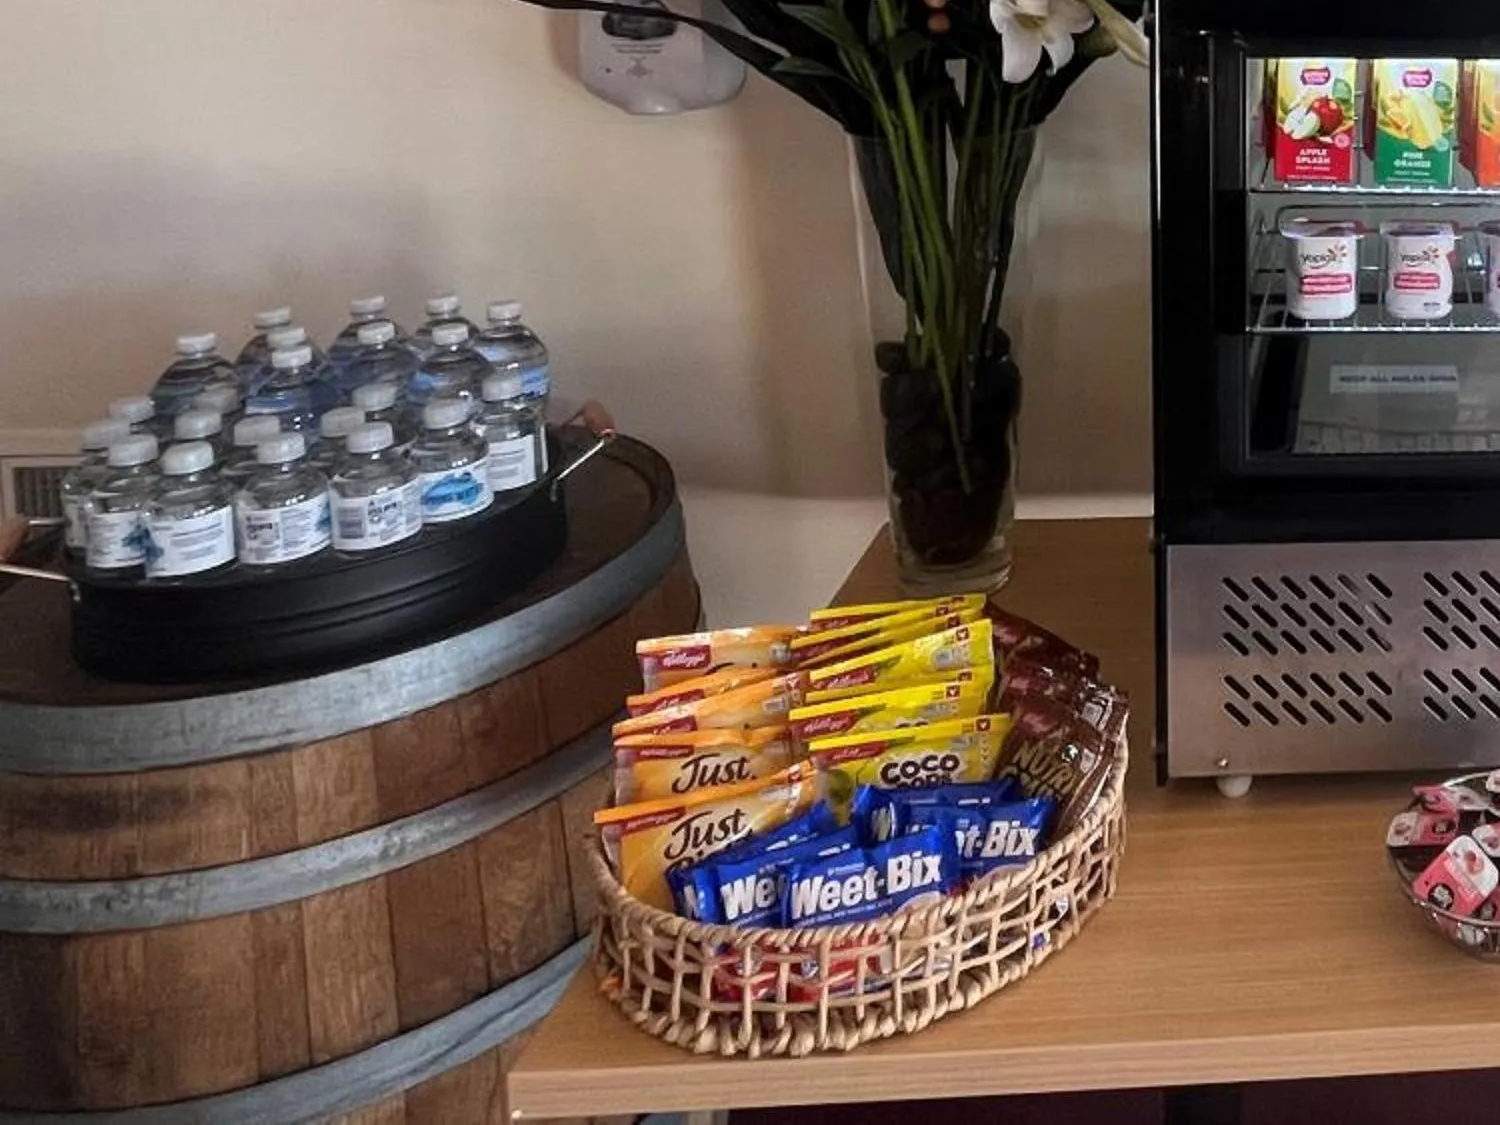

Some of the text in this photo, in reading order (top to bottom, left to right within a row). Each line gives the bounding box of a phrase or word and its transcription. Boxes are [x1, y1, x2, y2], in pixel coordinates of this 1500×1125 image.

[671, 753, 751, 794] Just
[880, 754, 960, 784] COCO
[663, 808, 748, 860] Just
[791, 850, 942, 921] Weet-Bix
